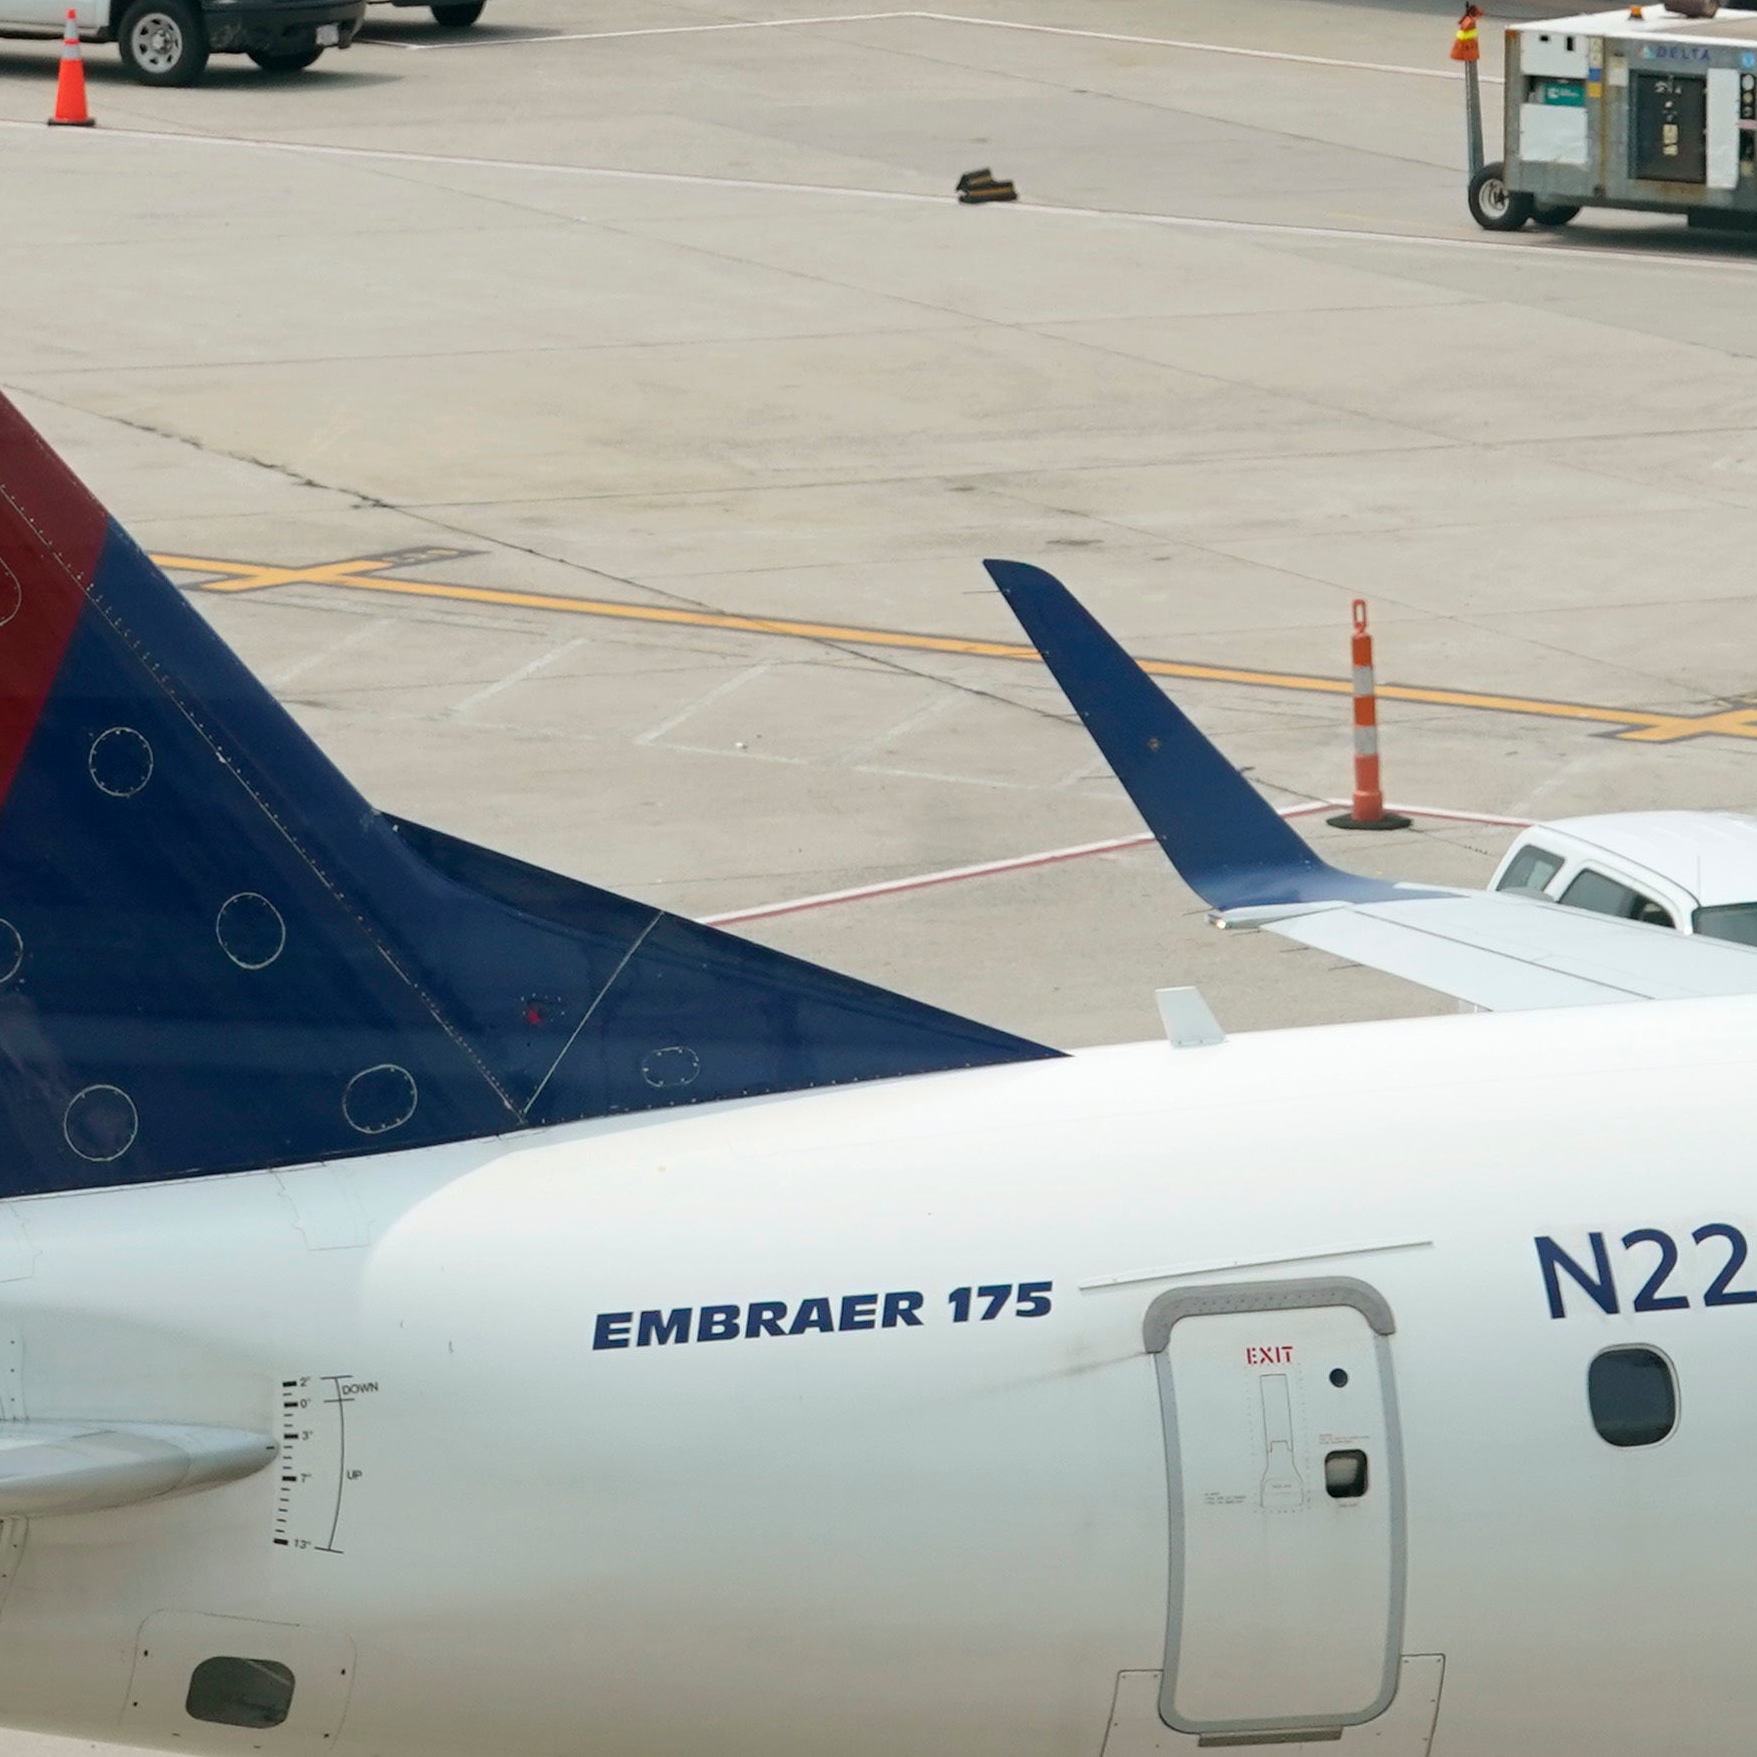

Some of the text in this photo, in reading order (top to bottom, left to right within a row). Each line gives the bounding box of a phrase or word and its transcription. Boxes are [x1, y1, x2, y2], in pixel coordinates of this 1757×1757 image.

[1655, 45, 1712, 61] DELTA
[591, 1280, 1054, 1351] EMBRAER 175
[1245, 1345, 1294, 1365] EXIT
[342, 1382, 379, 1396] DOWN
[346, 1469, 363, 1481] UP
